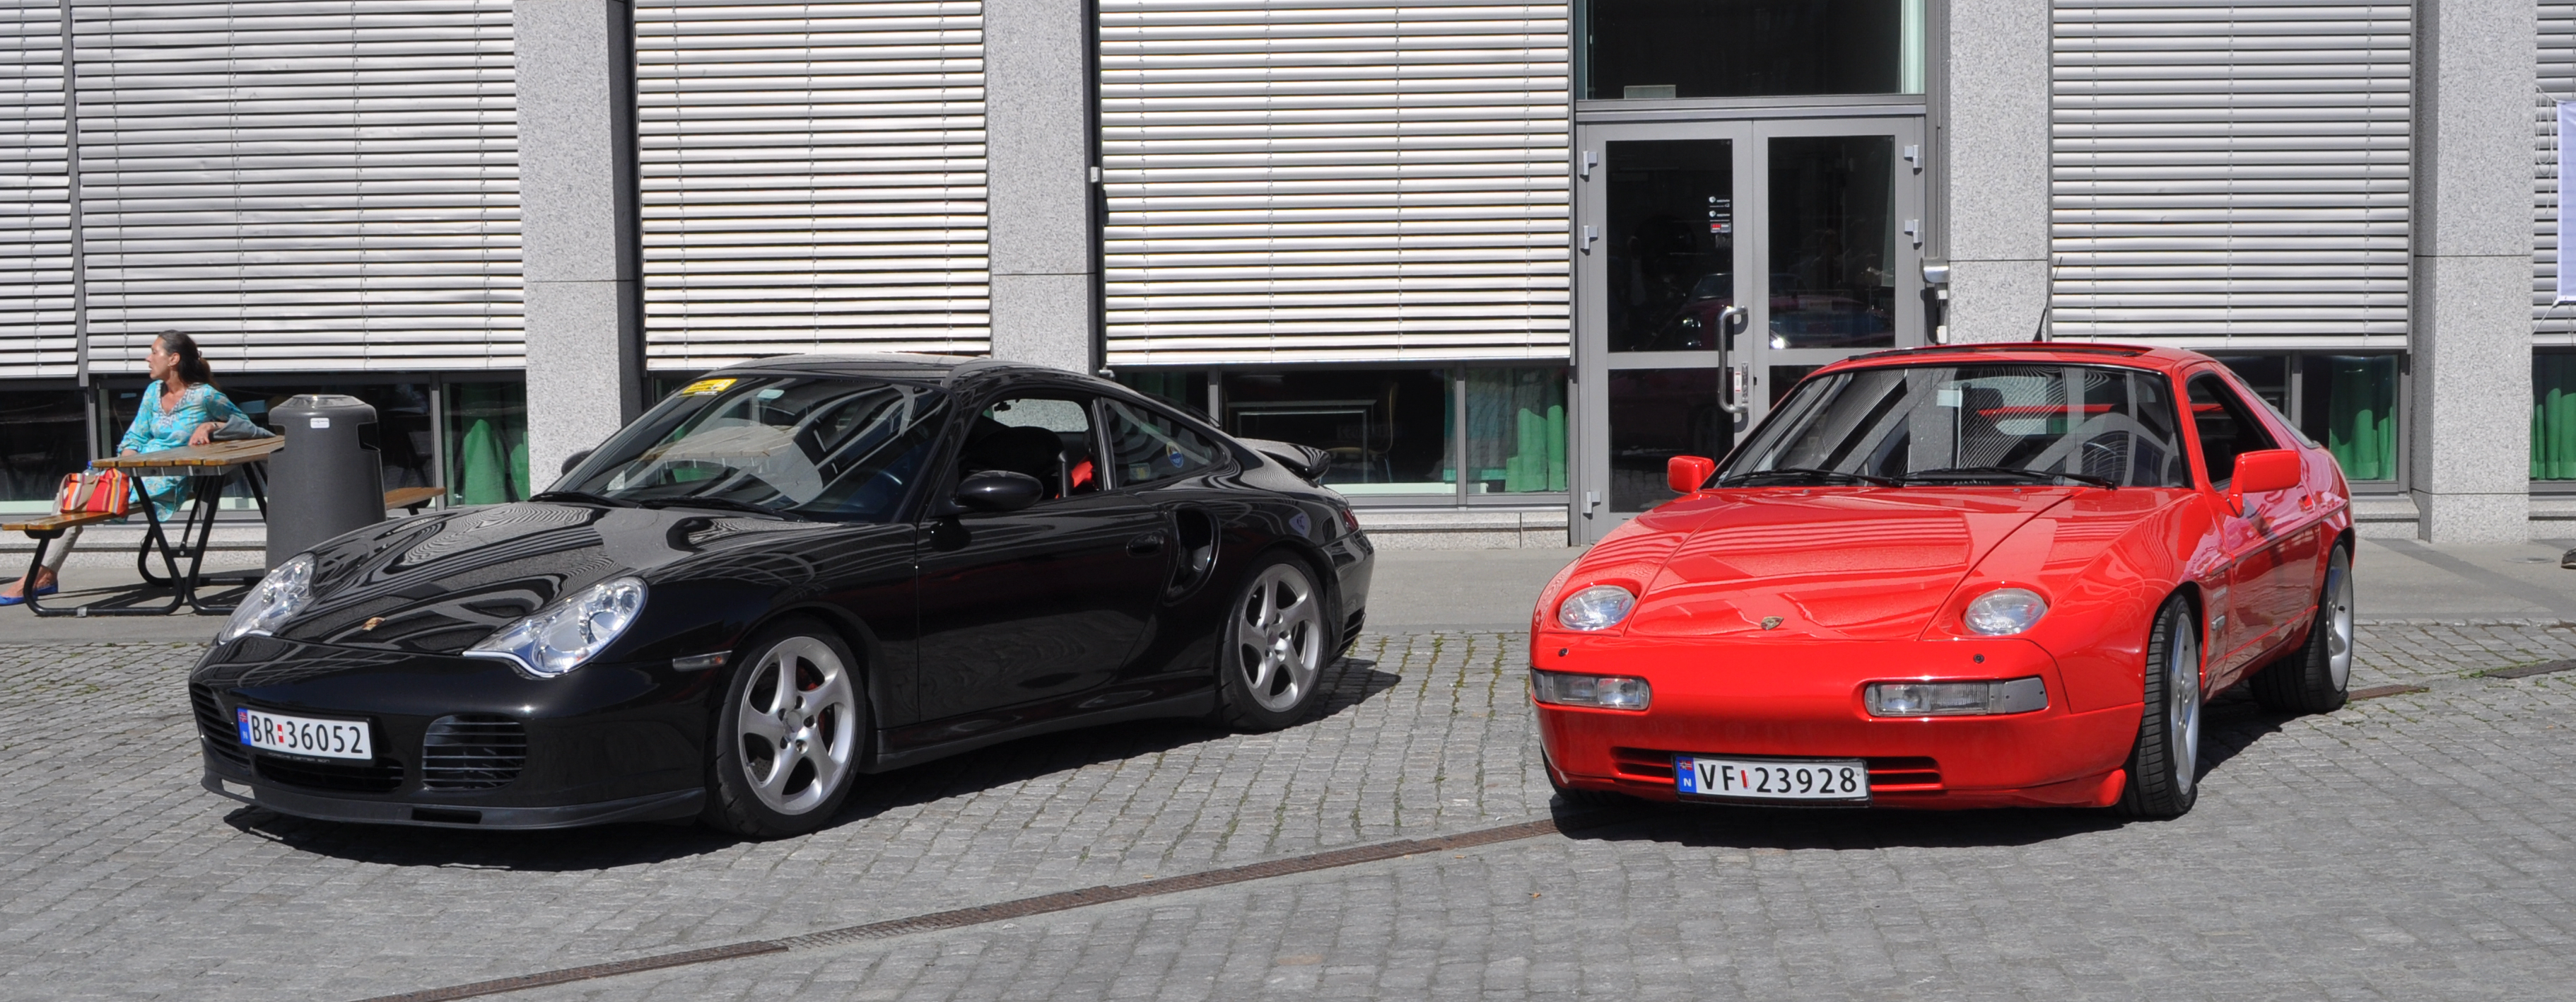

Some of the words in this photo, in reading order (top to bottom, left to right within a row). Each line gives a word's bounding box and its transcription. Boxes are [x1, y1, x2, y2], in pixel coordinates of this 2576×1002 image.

[250, 715, 276, 745] BR
[286, 721, 363, 754] 36052
[1683, 778, 1692, 787] N
[1698, 763, 1735, 791] VF
[1755, 767, 1857, 794] 23928
